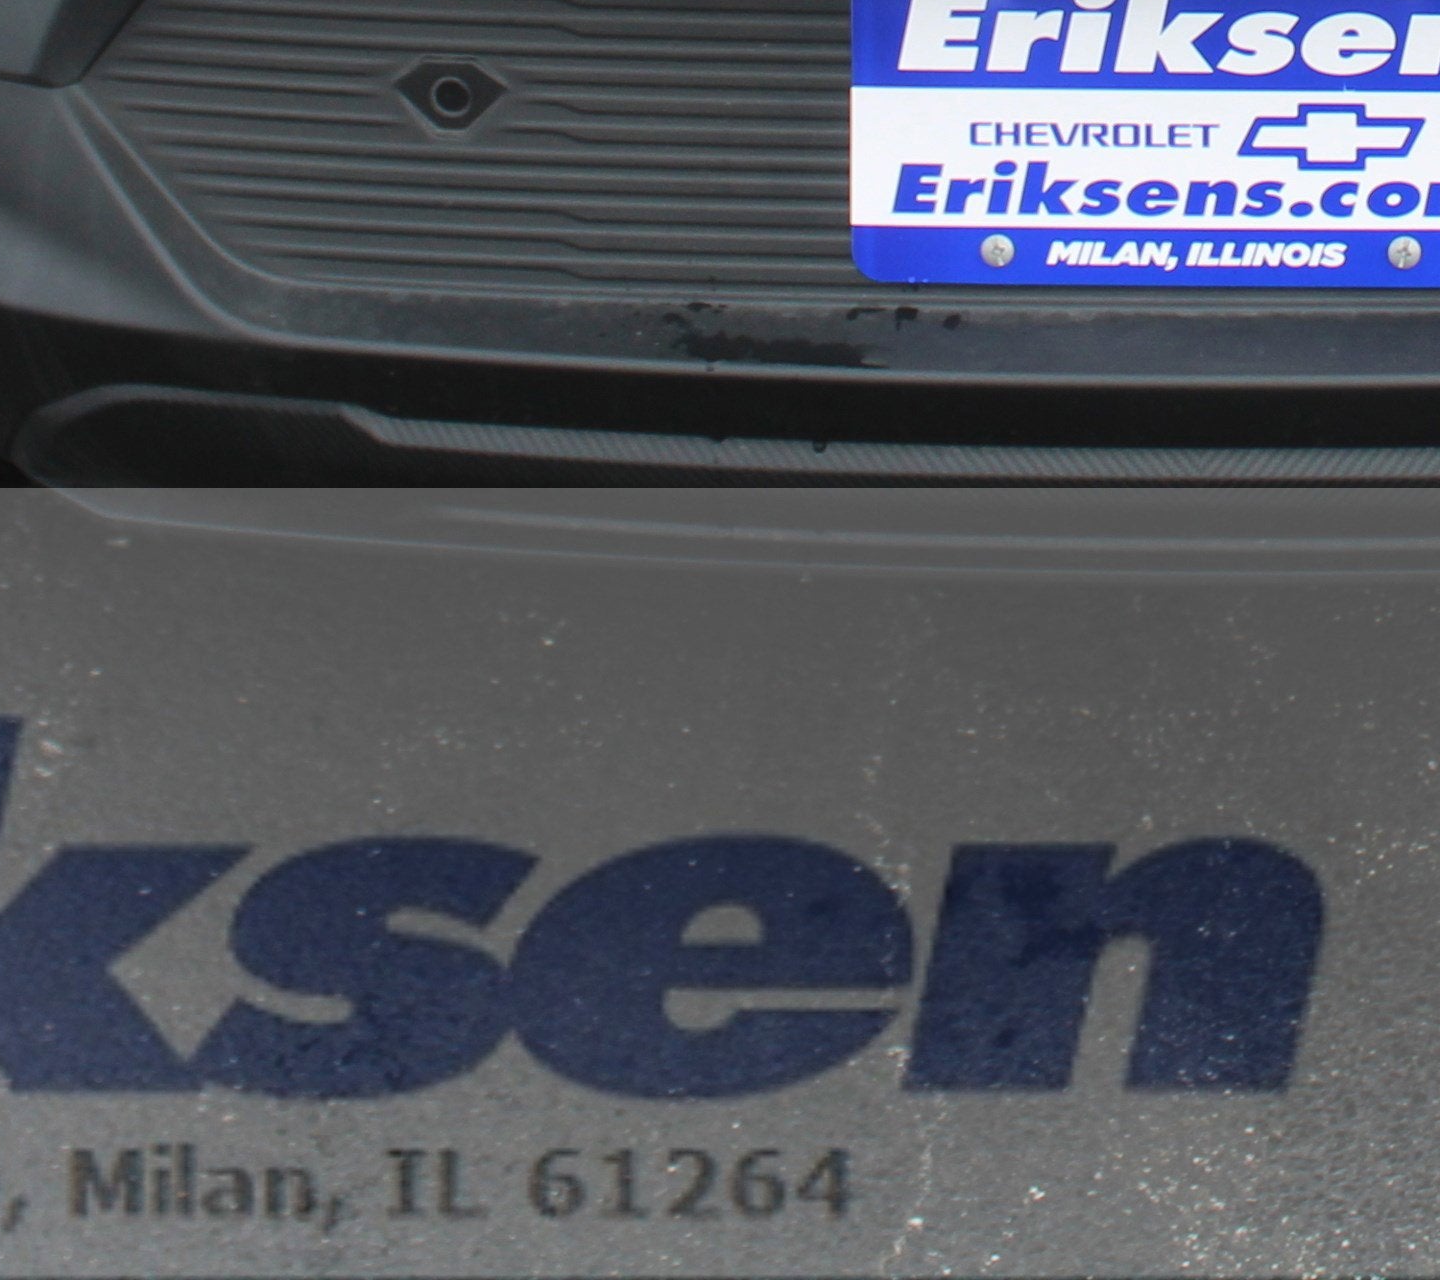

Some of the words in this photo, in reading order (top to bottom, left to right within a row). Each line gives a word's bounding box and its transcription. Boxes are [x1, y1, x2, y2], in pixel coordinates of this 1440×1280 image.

[969, 121, 1220, 148] CHEVROLET
[1045, 241, 1177, 272] MILAN,
[1186, 241, 1347, 269] ILLINOIS
